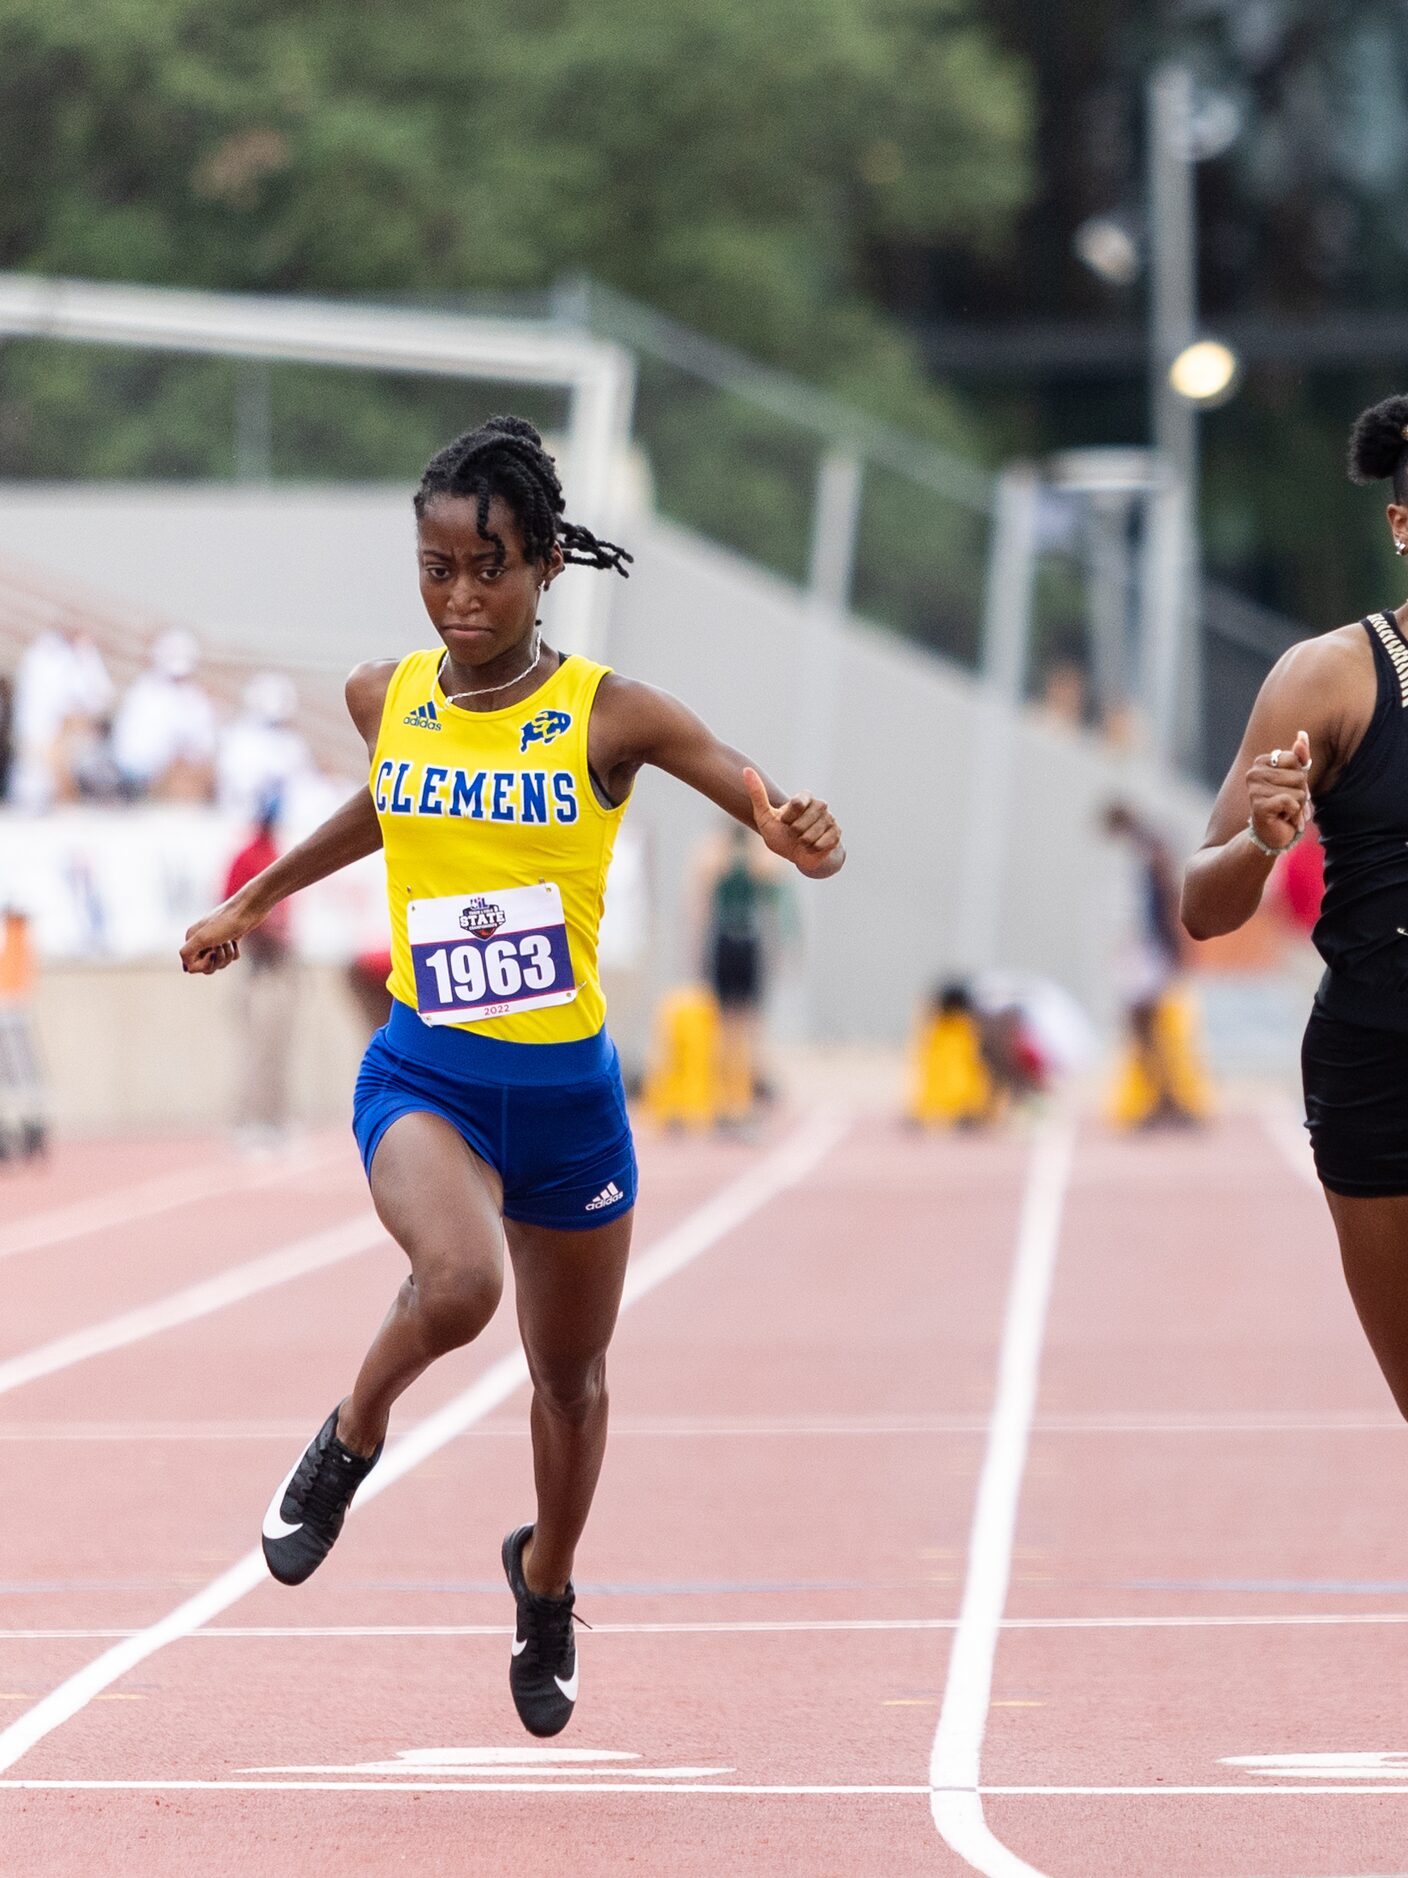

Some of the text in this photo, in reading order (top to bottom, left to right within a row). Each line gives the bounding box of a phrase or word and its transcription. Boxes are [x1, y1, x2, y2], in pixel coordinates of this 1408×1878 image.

[403, 716, 442, 732] adidas
[375, 759, 580, 825] CLEMENS
[459, 910, 505, 928] STATE
[425, 934, 556, 1004] 1963
[484, 1004, 511, 1016] 2022
[585, 1191, 624, 1211] adidas
